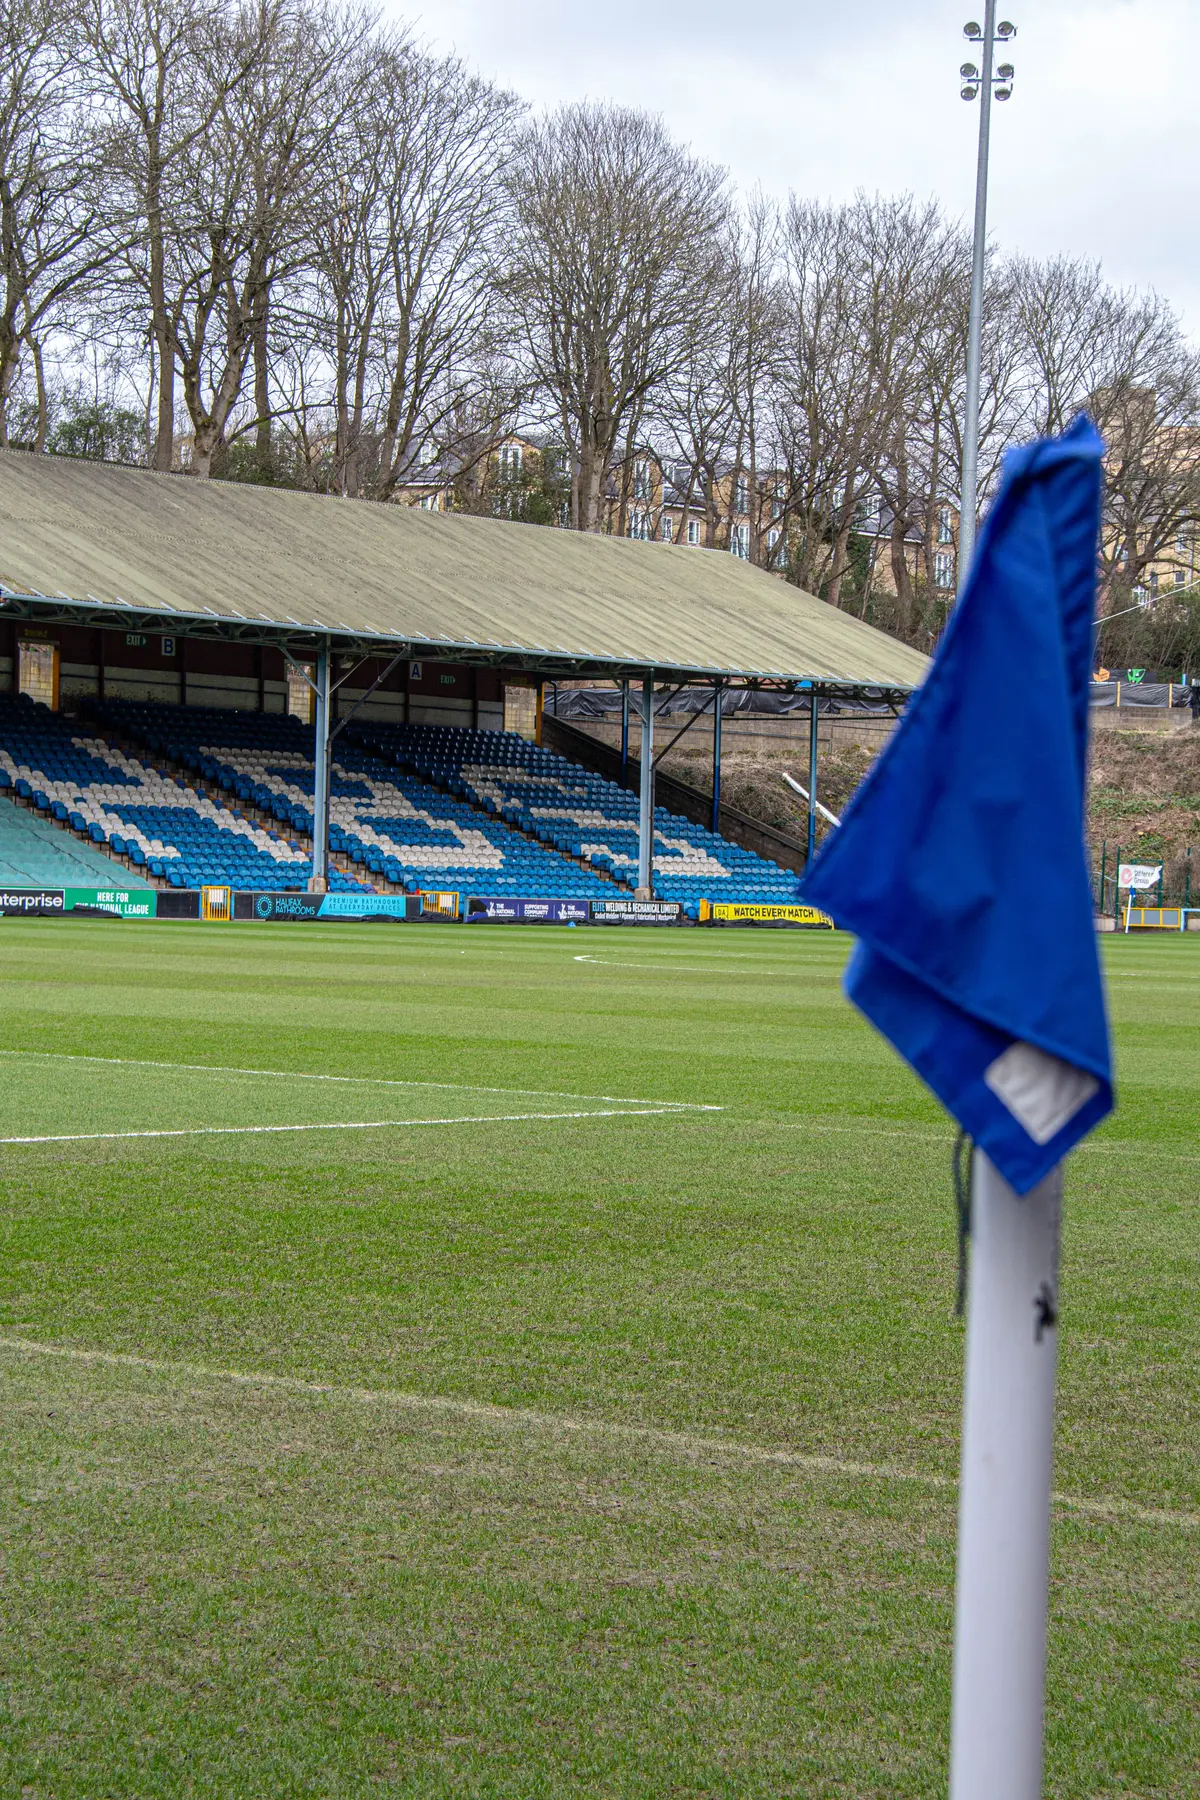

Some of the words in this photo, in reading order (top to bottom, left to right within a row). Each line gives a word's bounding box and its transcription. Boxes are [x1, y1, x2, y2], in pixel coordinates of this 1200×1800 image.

[126, 634, 141, 646] EXIT
[164, 638, 174, 654] B
[411, 663, 421, 678] A
[440, 674, 453, 684] EXIT
[0, 893, 63, 910] terprise
[97, 892, 115, 902] HERE
[116, 893, 129, 903] FOR
[275, 898, 302, 907] HALIFAX
[125, 904, 149, 915] LEAGUE
[275, 906, 316, 915] BATHROOMS
[376, 904, 401, 912] PRICES
[592, 902, 605, 912] ELITE
[605, 902, 627, 912] WELDING
[632, 903, 660, 913] MECHANICAL
[660, 904, 680, 914] LIMITED
[734, 907, 762, 917] WATCH
[762, 907, 787, 917] EVERY
[788, 908, 814, 918] MATCH
